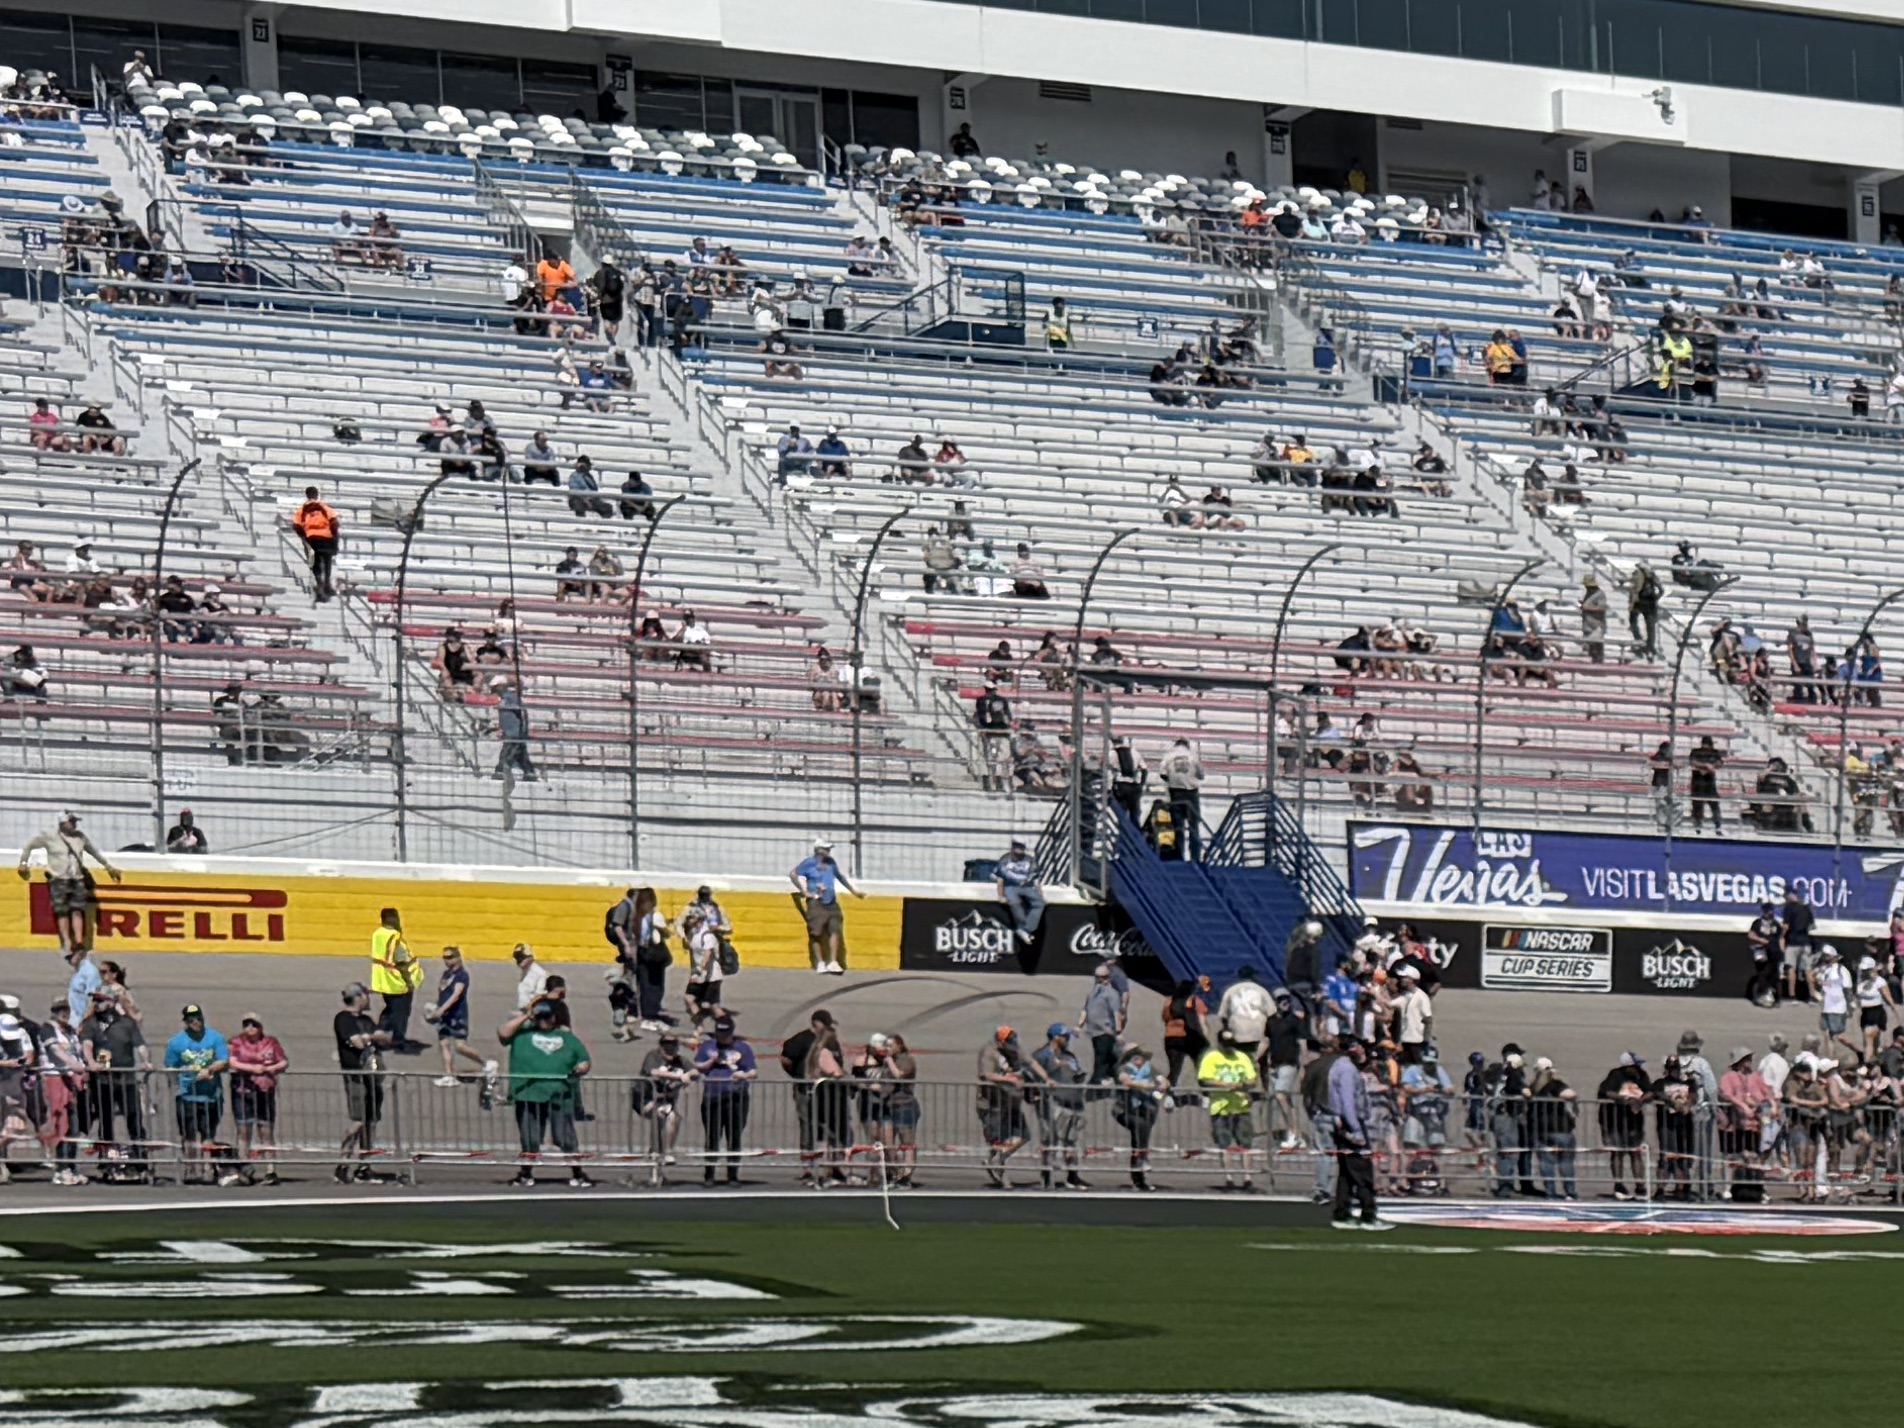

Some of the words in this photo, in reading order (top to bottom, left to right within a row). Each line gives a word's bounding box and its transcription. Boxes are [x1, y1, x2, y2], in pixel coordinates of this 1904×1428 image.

[30, 883, 288, 942] PRELLI
[935, 926, 1015, 954] BUSCH
[1524, 930, 1593, 951] NASCAR
[1501, 958, 1535, 976] CUP
[1536, 958, 1595, 978] SERIES
[1642, 956, 1711, 979] BUSCH
